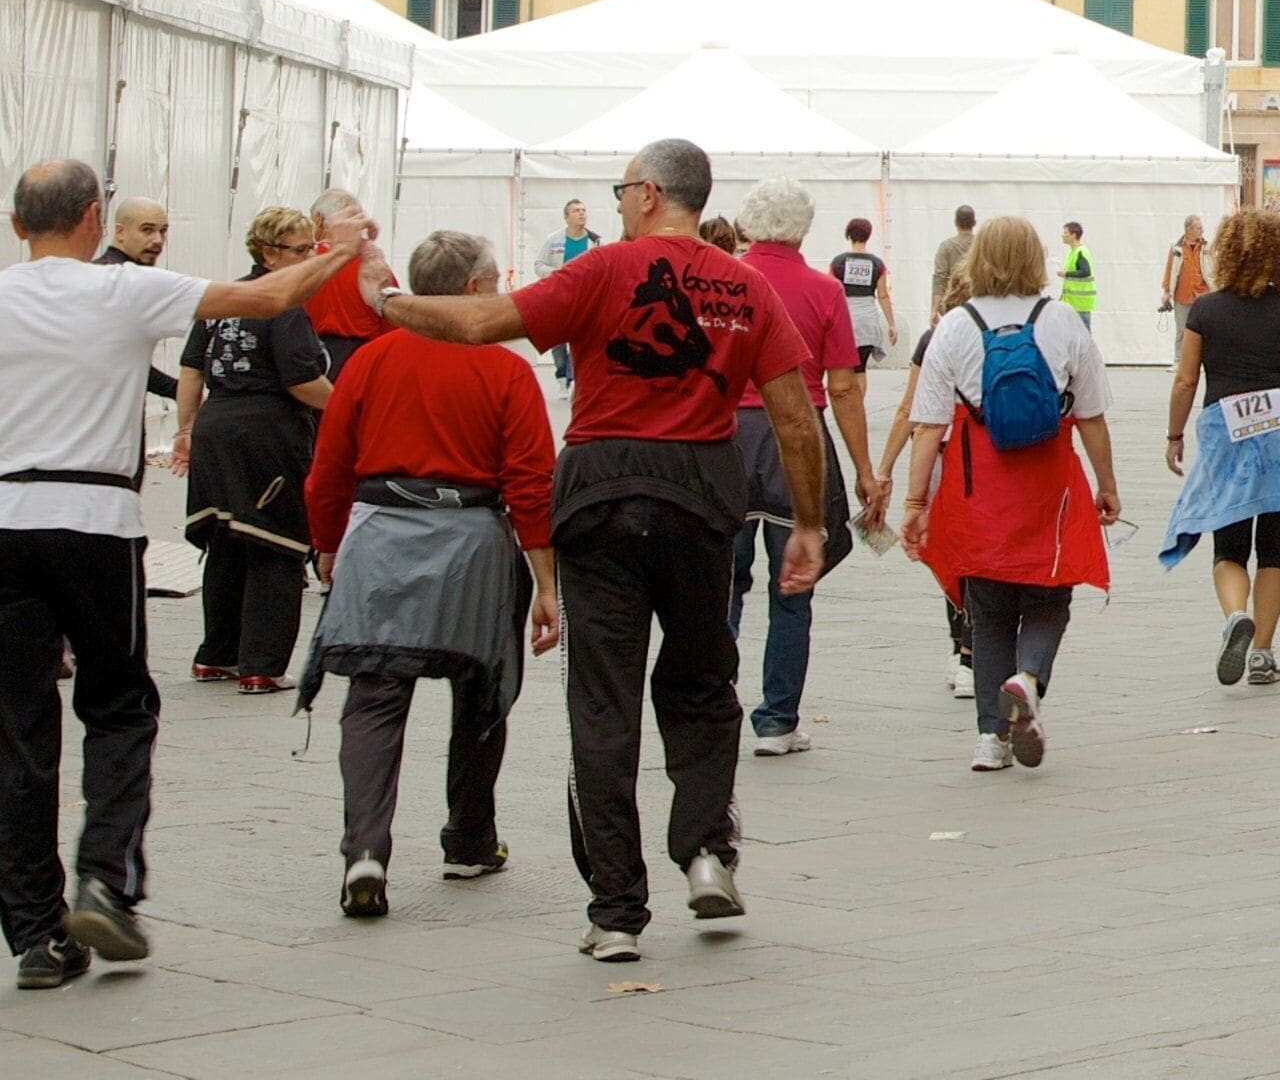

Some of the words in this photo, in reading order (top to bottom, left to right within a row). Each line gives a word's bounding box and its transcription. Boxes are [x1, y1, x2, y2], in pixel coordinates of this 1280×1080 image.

[681, 263, 748, 300] bossa
[848, 266, 871, 277] 2329
[1232, 392, 1273, 419] 1721
